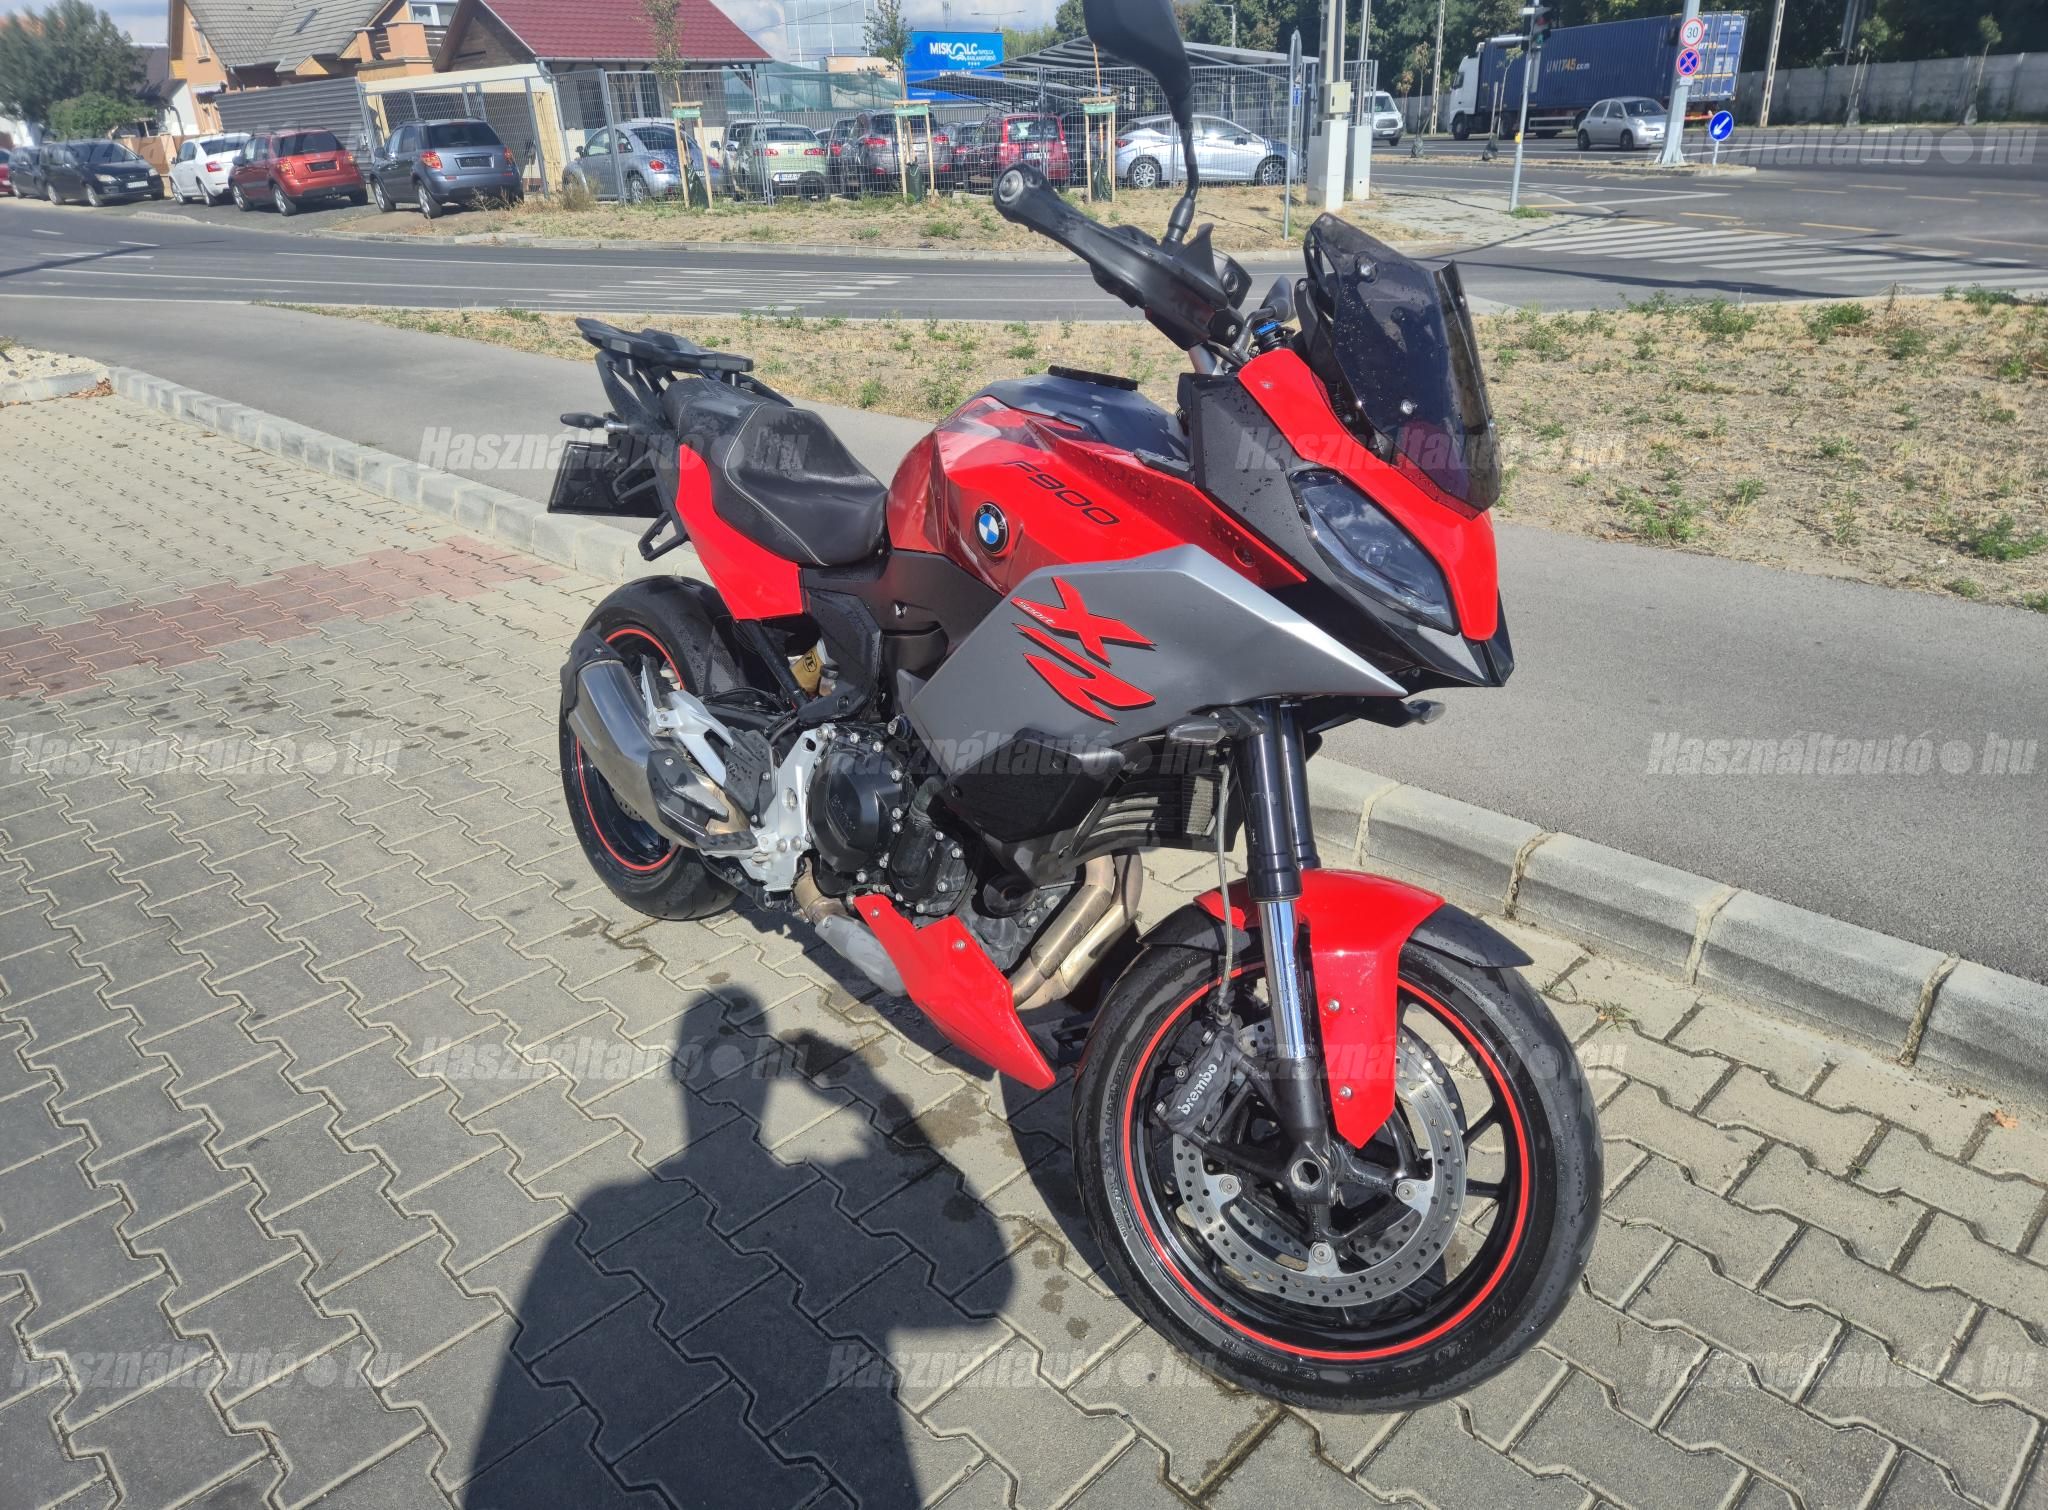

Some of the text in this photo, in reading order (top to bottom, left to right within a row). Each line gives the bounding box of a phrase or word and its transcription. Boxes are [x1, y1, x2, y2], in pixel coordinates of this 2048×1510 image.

[930, 42, 977, 57] MISKOLC
[1686, 27, 1699, 38] 30
[1003, 460, 1120, 526] F900
[1177, 1063, 1218, 1116] brembo
